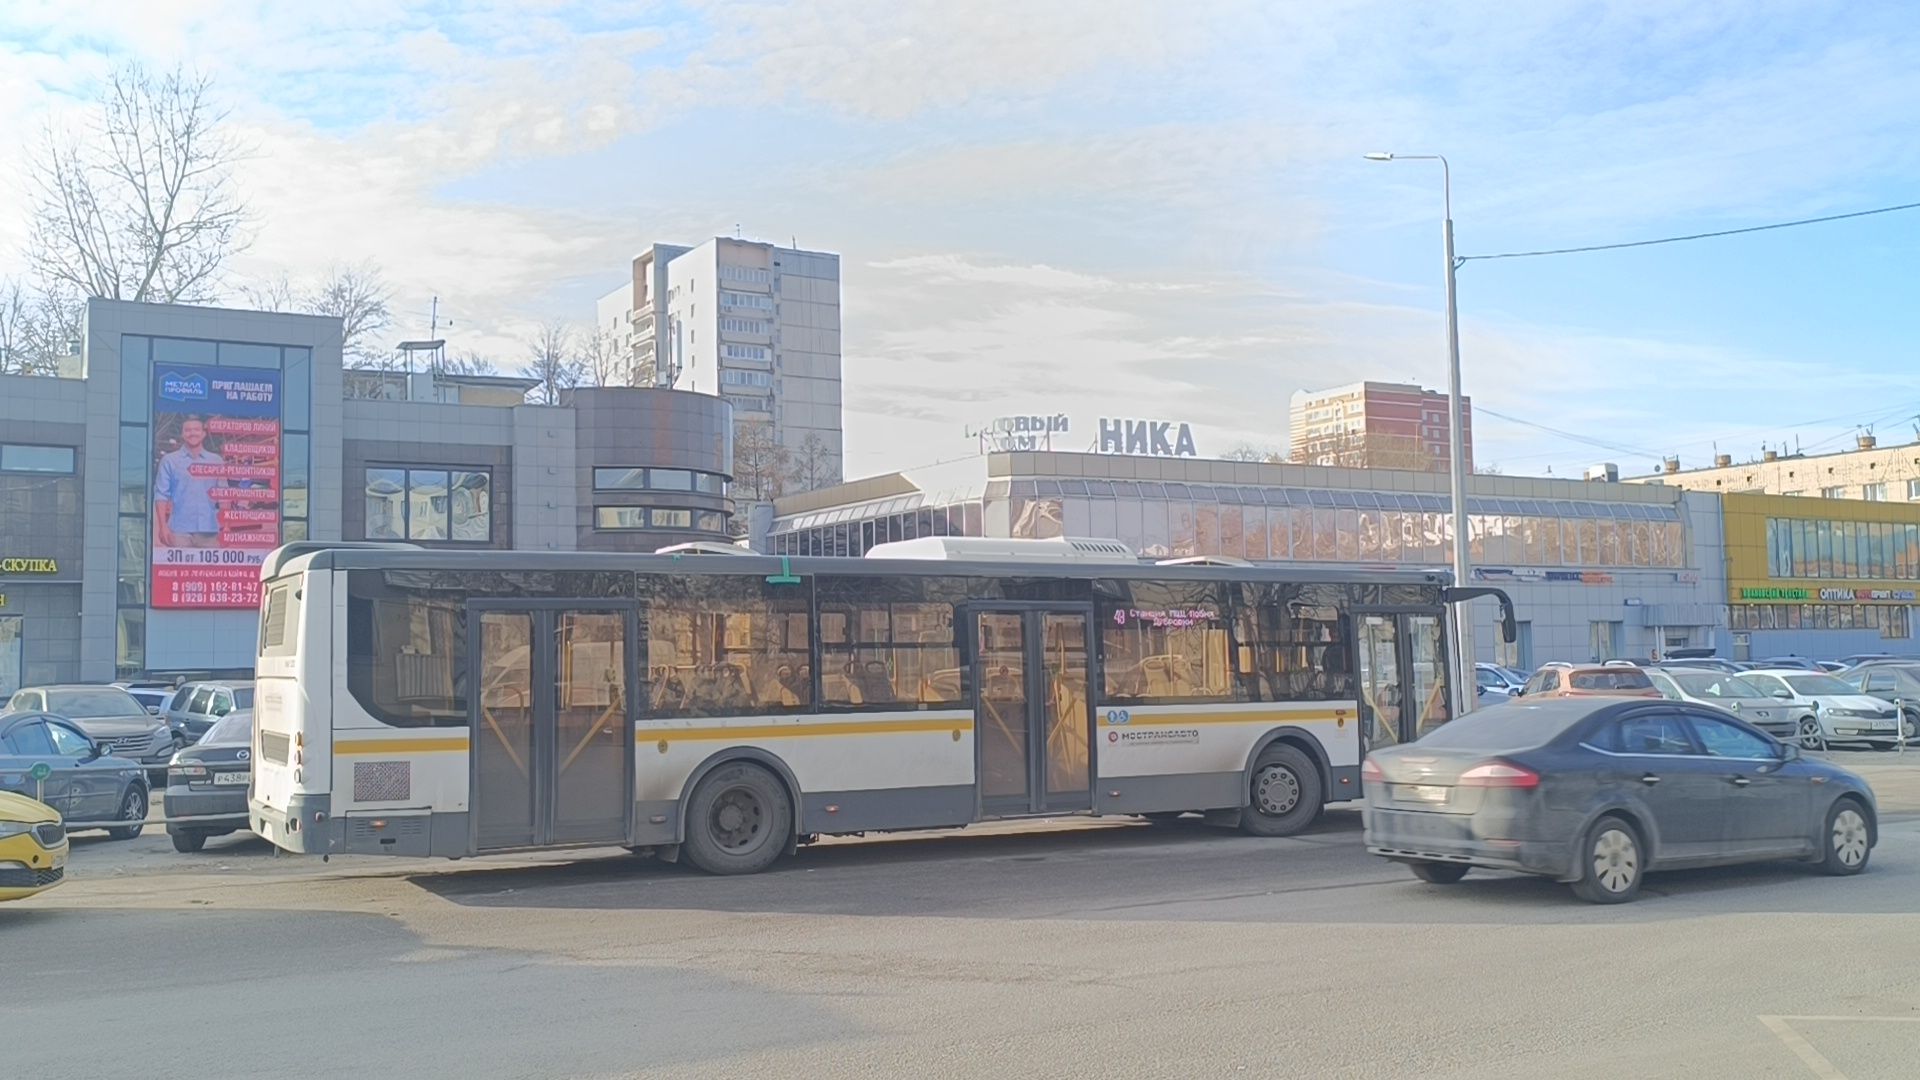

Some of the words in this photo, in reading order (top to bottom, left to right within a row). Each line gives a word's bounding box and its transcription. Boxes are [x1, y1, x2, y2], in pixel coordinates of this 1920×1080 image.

[165, 381, 201, 389] МЕТАЛЛ
[165, 387, 203, 395] ПРОФИЛЬ
[212, 380, 273, 393] ПРИГЛАШАЕМ
[226, 391, 238, 400] НА
[241, 391, 273, 402] РАБОТУ
[1099, 417, 1197, 456] НИКА
[167, 549, 183, 562] ЗП
[199, 550, 219, 563] 105
[223, 550, 244, 563] 000
[1820, 588, 1856, 600] ОПТИКА
